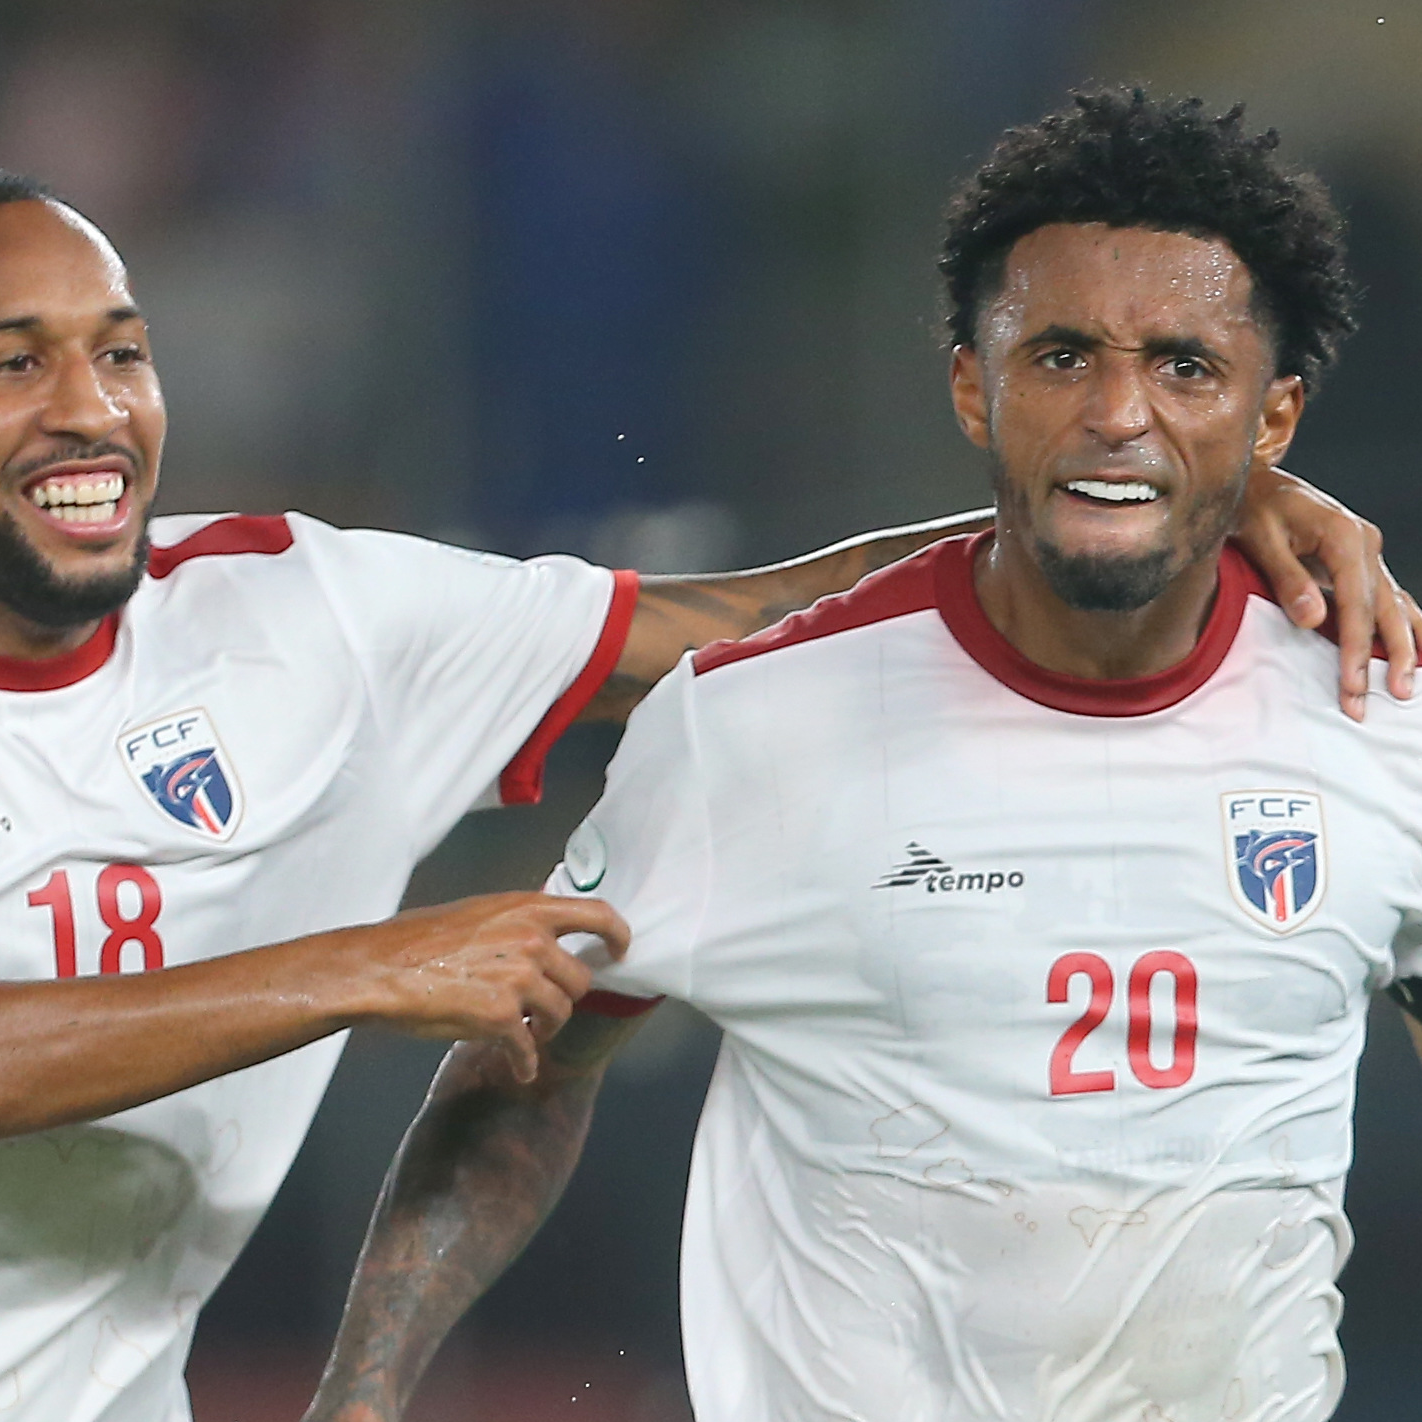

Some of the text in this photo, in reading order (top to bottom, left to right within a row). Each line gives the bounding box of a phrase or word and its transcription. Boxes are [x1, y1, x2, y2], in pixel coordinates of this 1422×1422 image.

[126, 716, 199, 761] FCF
[1230, 797, 1311, 819] FCF
[926, 870, 1025, 893] tempo
[28, 861, 164, 979] 18
[1046, 949, 1198, 1096] 20
